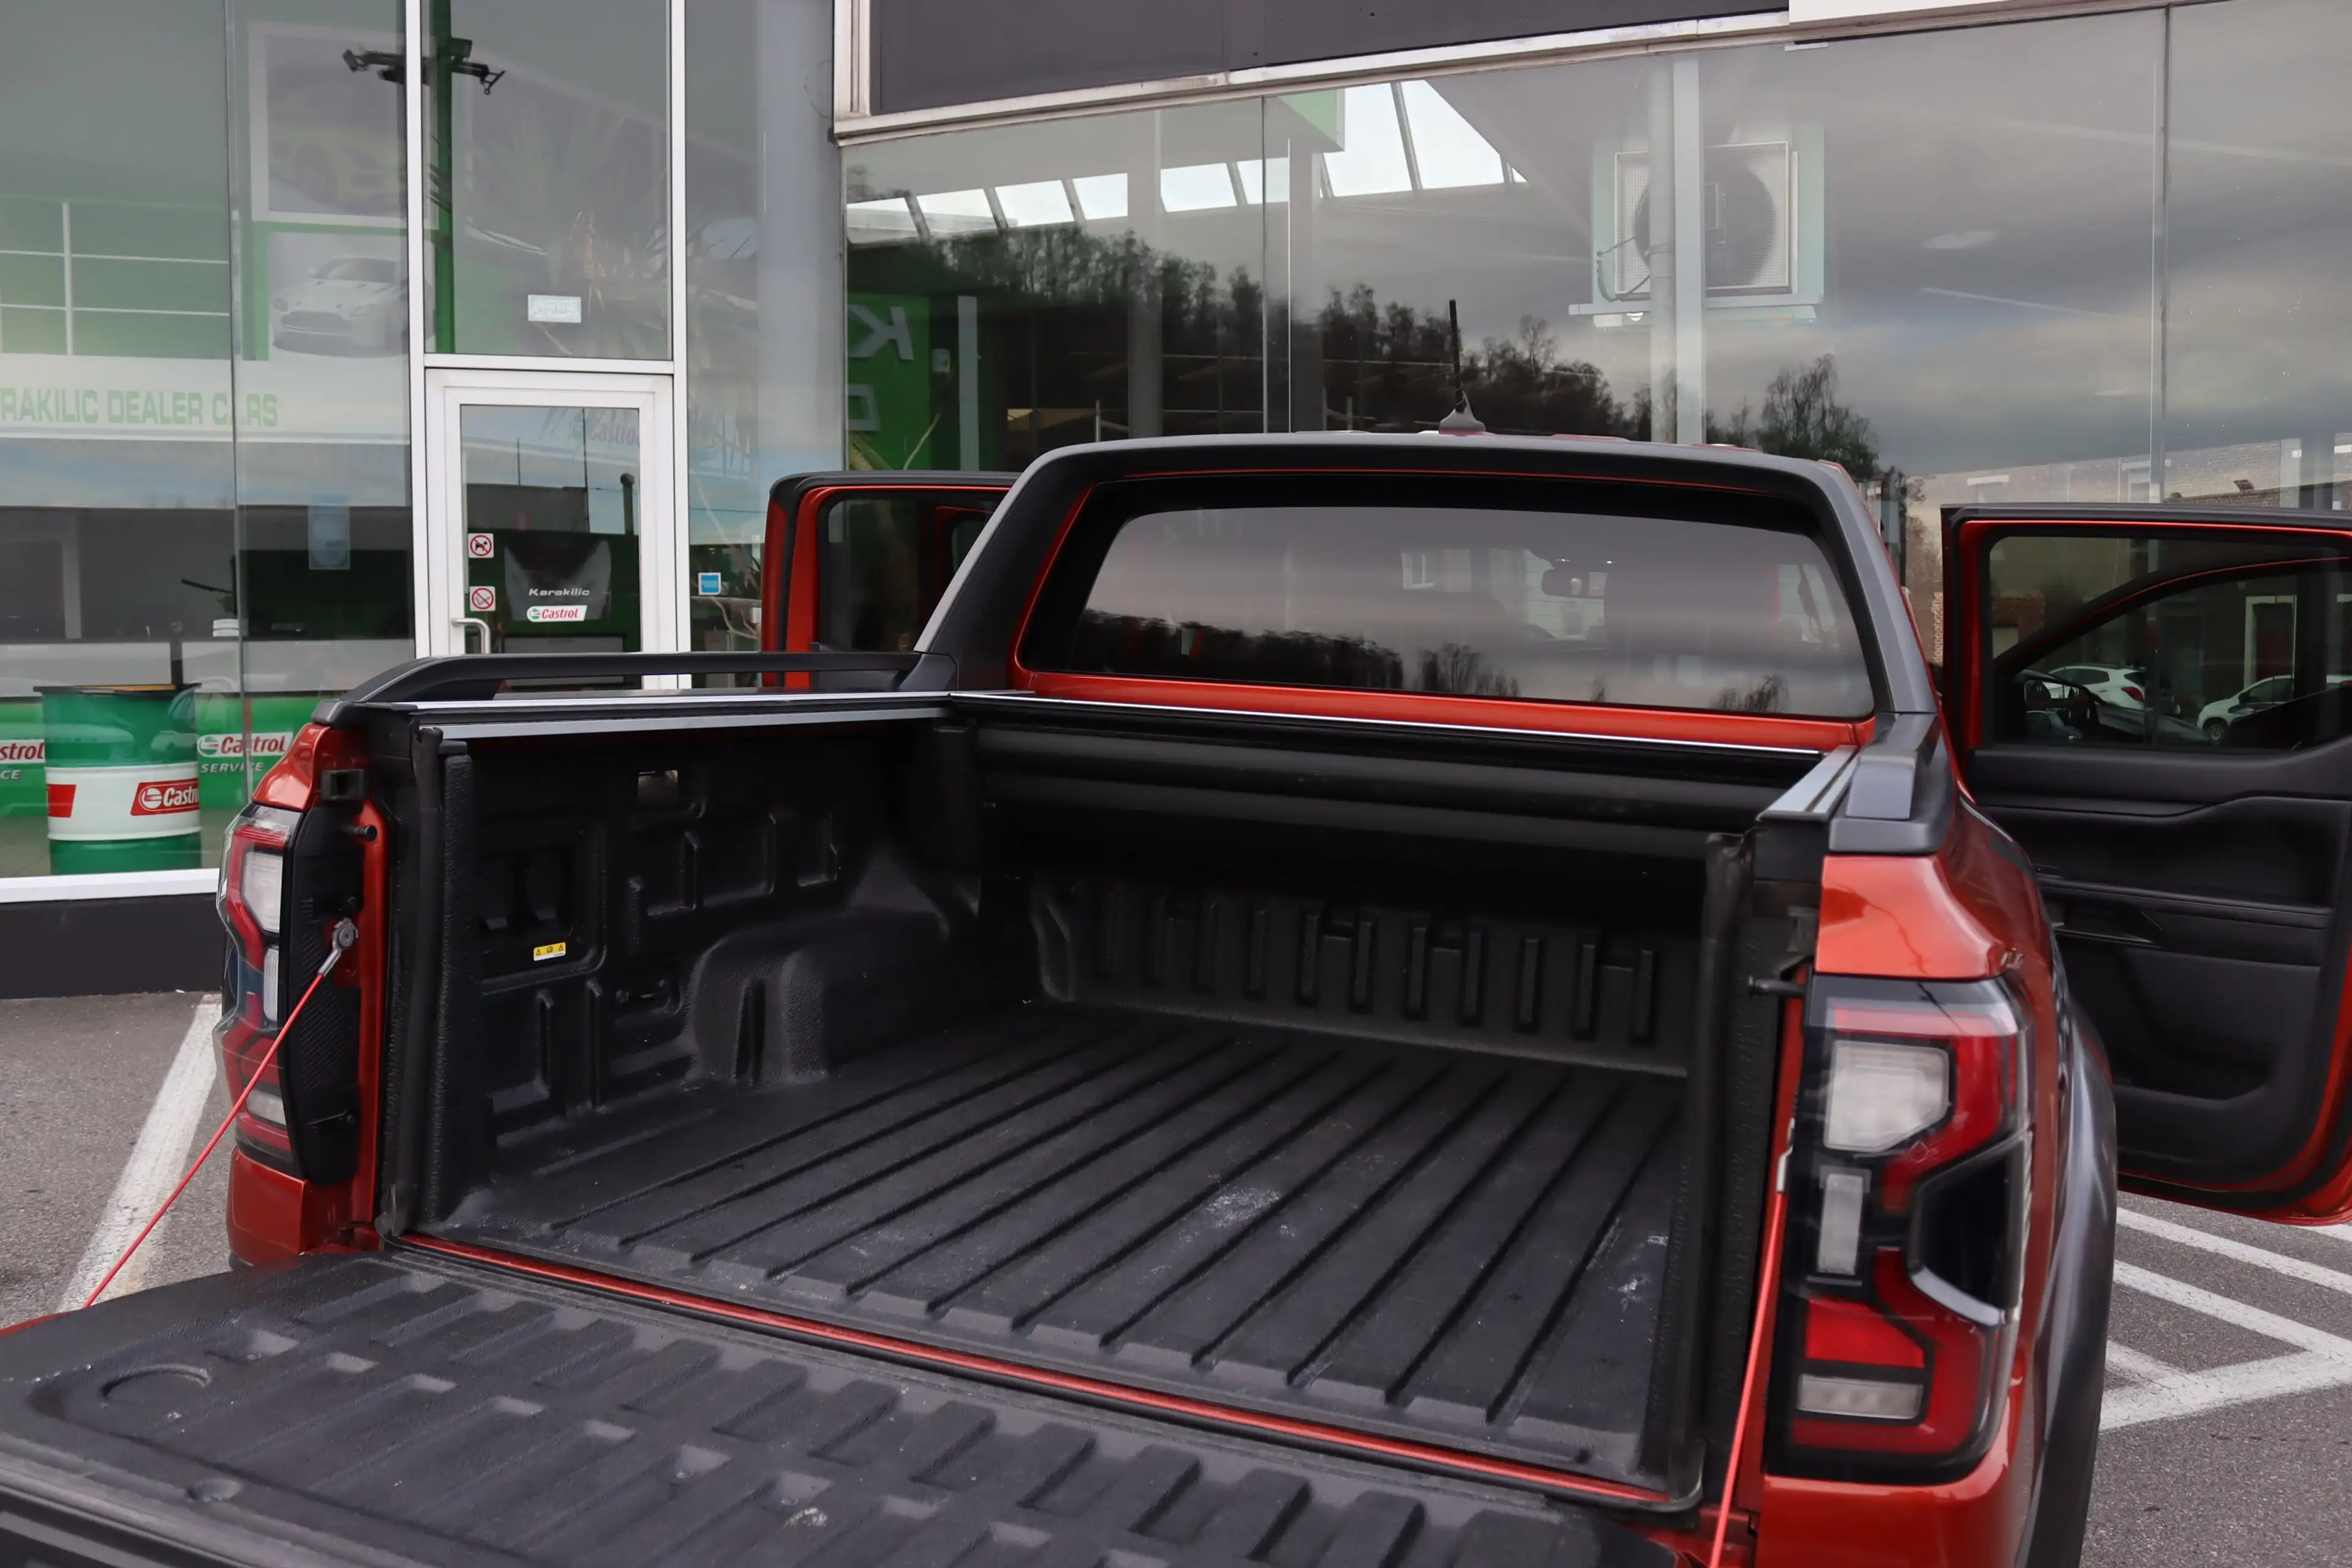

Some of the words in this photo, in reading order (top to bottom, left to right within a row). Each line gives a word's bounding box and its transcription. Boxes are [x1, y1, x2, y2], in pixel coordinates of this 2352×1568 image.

[0, 387, 99, 423] RAKILIC
[107, 390, 203, 425] DEALER
[529, 588, 590, 597] Karakilic
[541, 608, 578, 619] Castrol
[221, 735, 286, 755] Catrol
[200, 762, 264, 774] SERVIE
